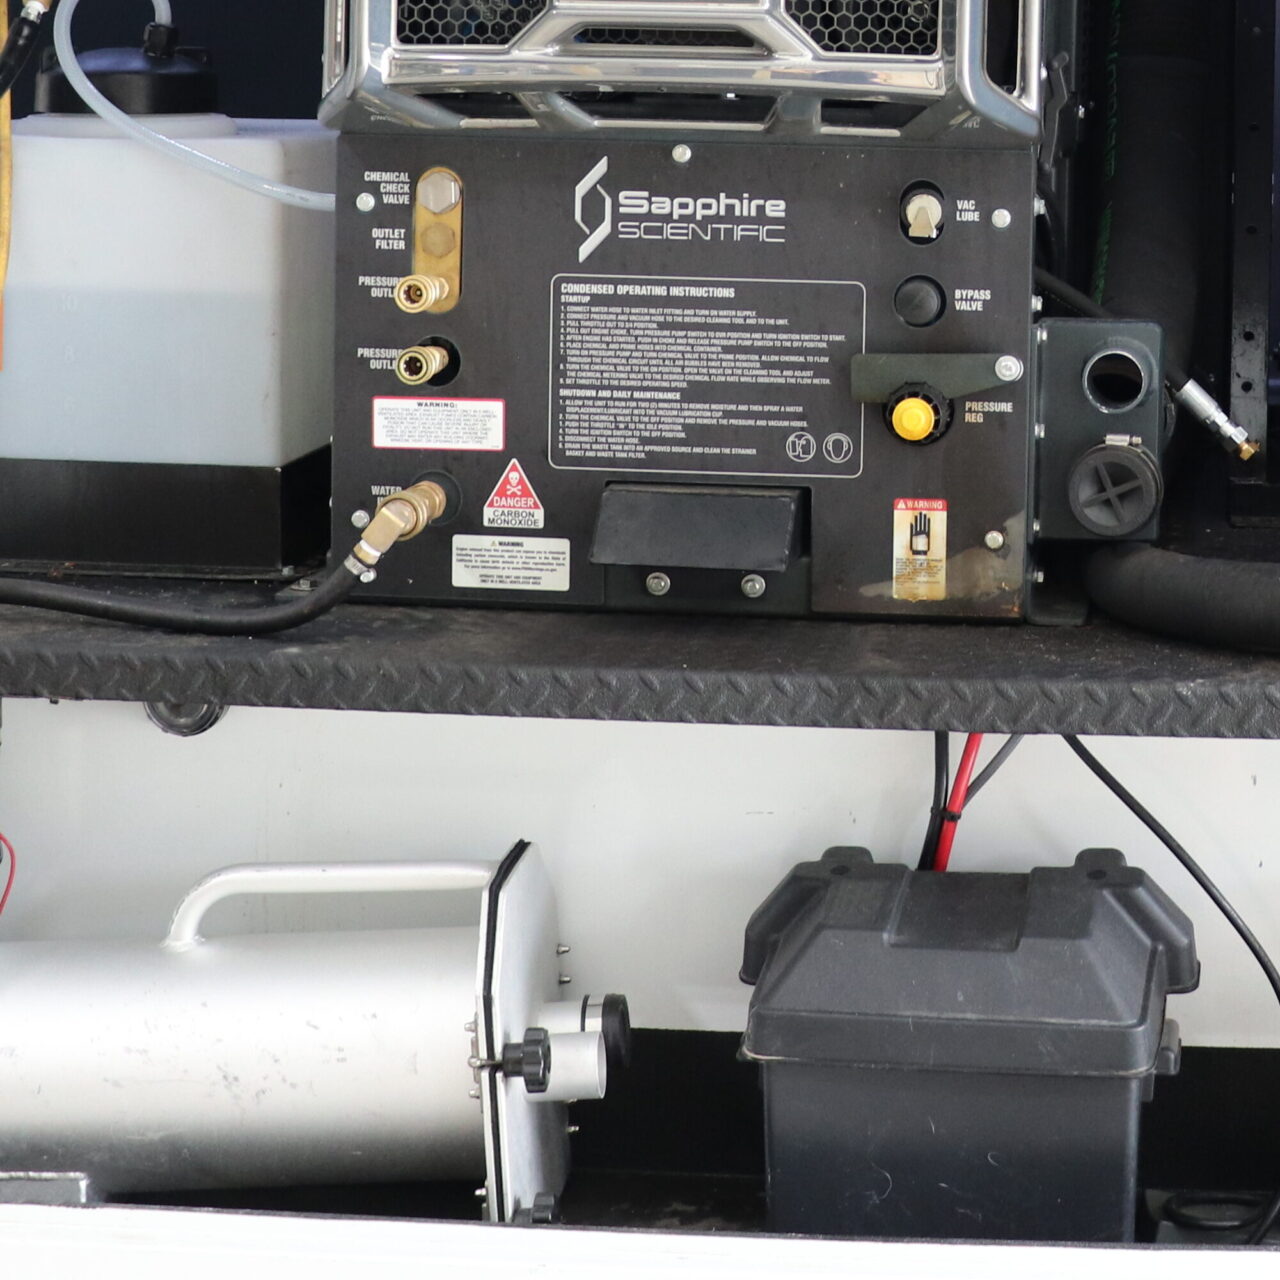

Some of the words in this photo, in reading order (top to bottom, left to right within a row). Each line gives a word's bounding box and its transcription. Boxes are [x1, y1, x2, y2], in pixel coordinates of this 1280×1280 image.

[364, 171, 411, 182] CHEMICAL
[379, 182, 410, 194] CHECK
[382, 194, 410, 205] VALVE
[956, 199, 976, 210] VAC
[618, 190, 786, 221] Sapphire
[956, 211, 980, 222] LUBE
[371, 227, 406, 239] OUTLET
[618, 222, 786, 244] SCIENTIFIC
[375, 239, 406, 251] FILTER
[560, 283, 615, 294] CONDENSED
[616, 284, 668, 296] OPERATING
[669, 286, 735, 298] INSTRUCTIONS
[954, 288, 991, 301] BYPASS
[560, 295, 590, 303] STARTUP
[954, 300, 984, 312] VALVE
[559, 389, 597, 398] SHUTDOWN
[598, 390, 612, 398] AND
[613, 390, 632, 399] DAILY
[633, 391, 681, 400] MAINTENANCE
[417, 401, 457, 409] WARNING:
[965, 401, 1014, 413] PRESSURE
[964, 412, 983, 423] REG
[493, 497, 535, 508] DANGER
[906, 500, 943, 510] WARNING
[492, 510, 535, 519] CARBON
[487, 518, 540, 528] MONOXIDE
